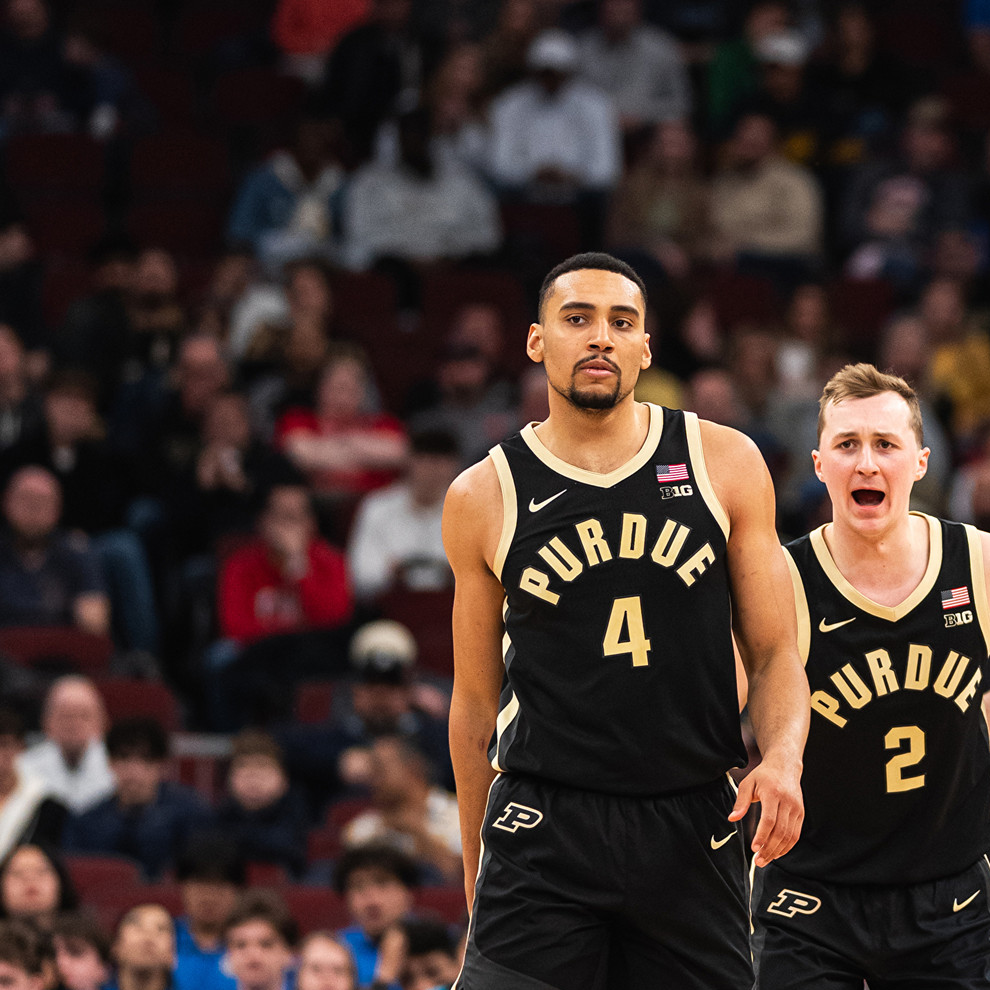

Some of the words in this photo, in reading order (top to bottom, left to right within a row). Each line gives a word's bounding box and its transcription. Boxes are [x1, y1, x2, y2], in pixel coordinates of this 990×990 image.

[519, 512, 716, 605] PURDUE
[602, 596, 651, 667] 4
[810, 643, 982, 729] PURDUE
[884, 725, 925, 793] 2
[492, 802, 543, 833] P
[767, 889, 821, 918] P
